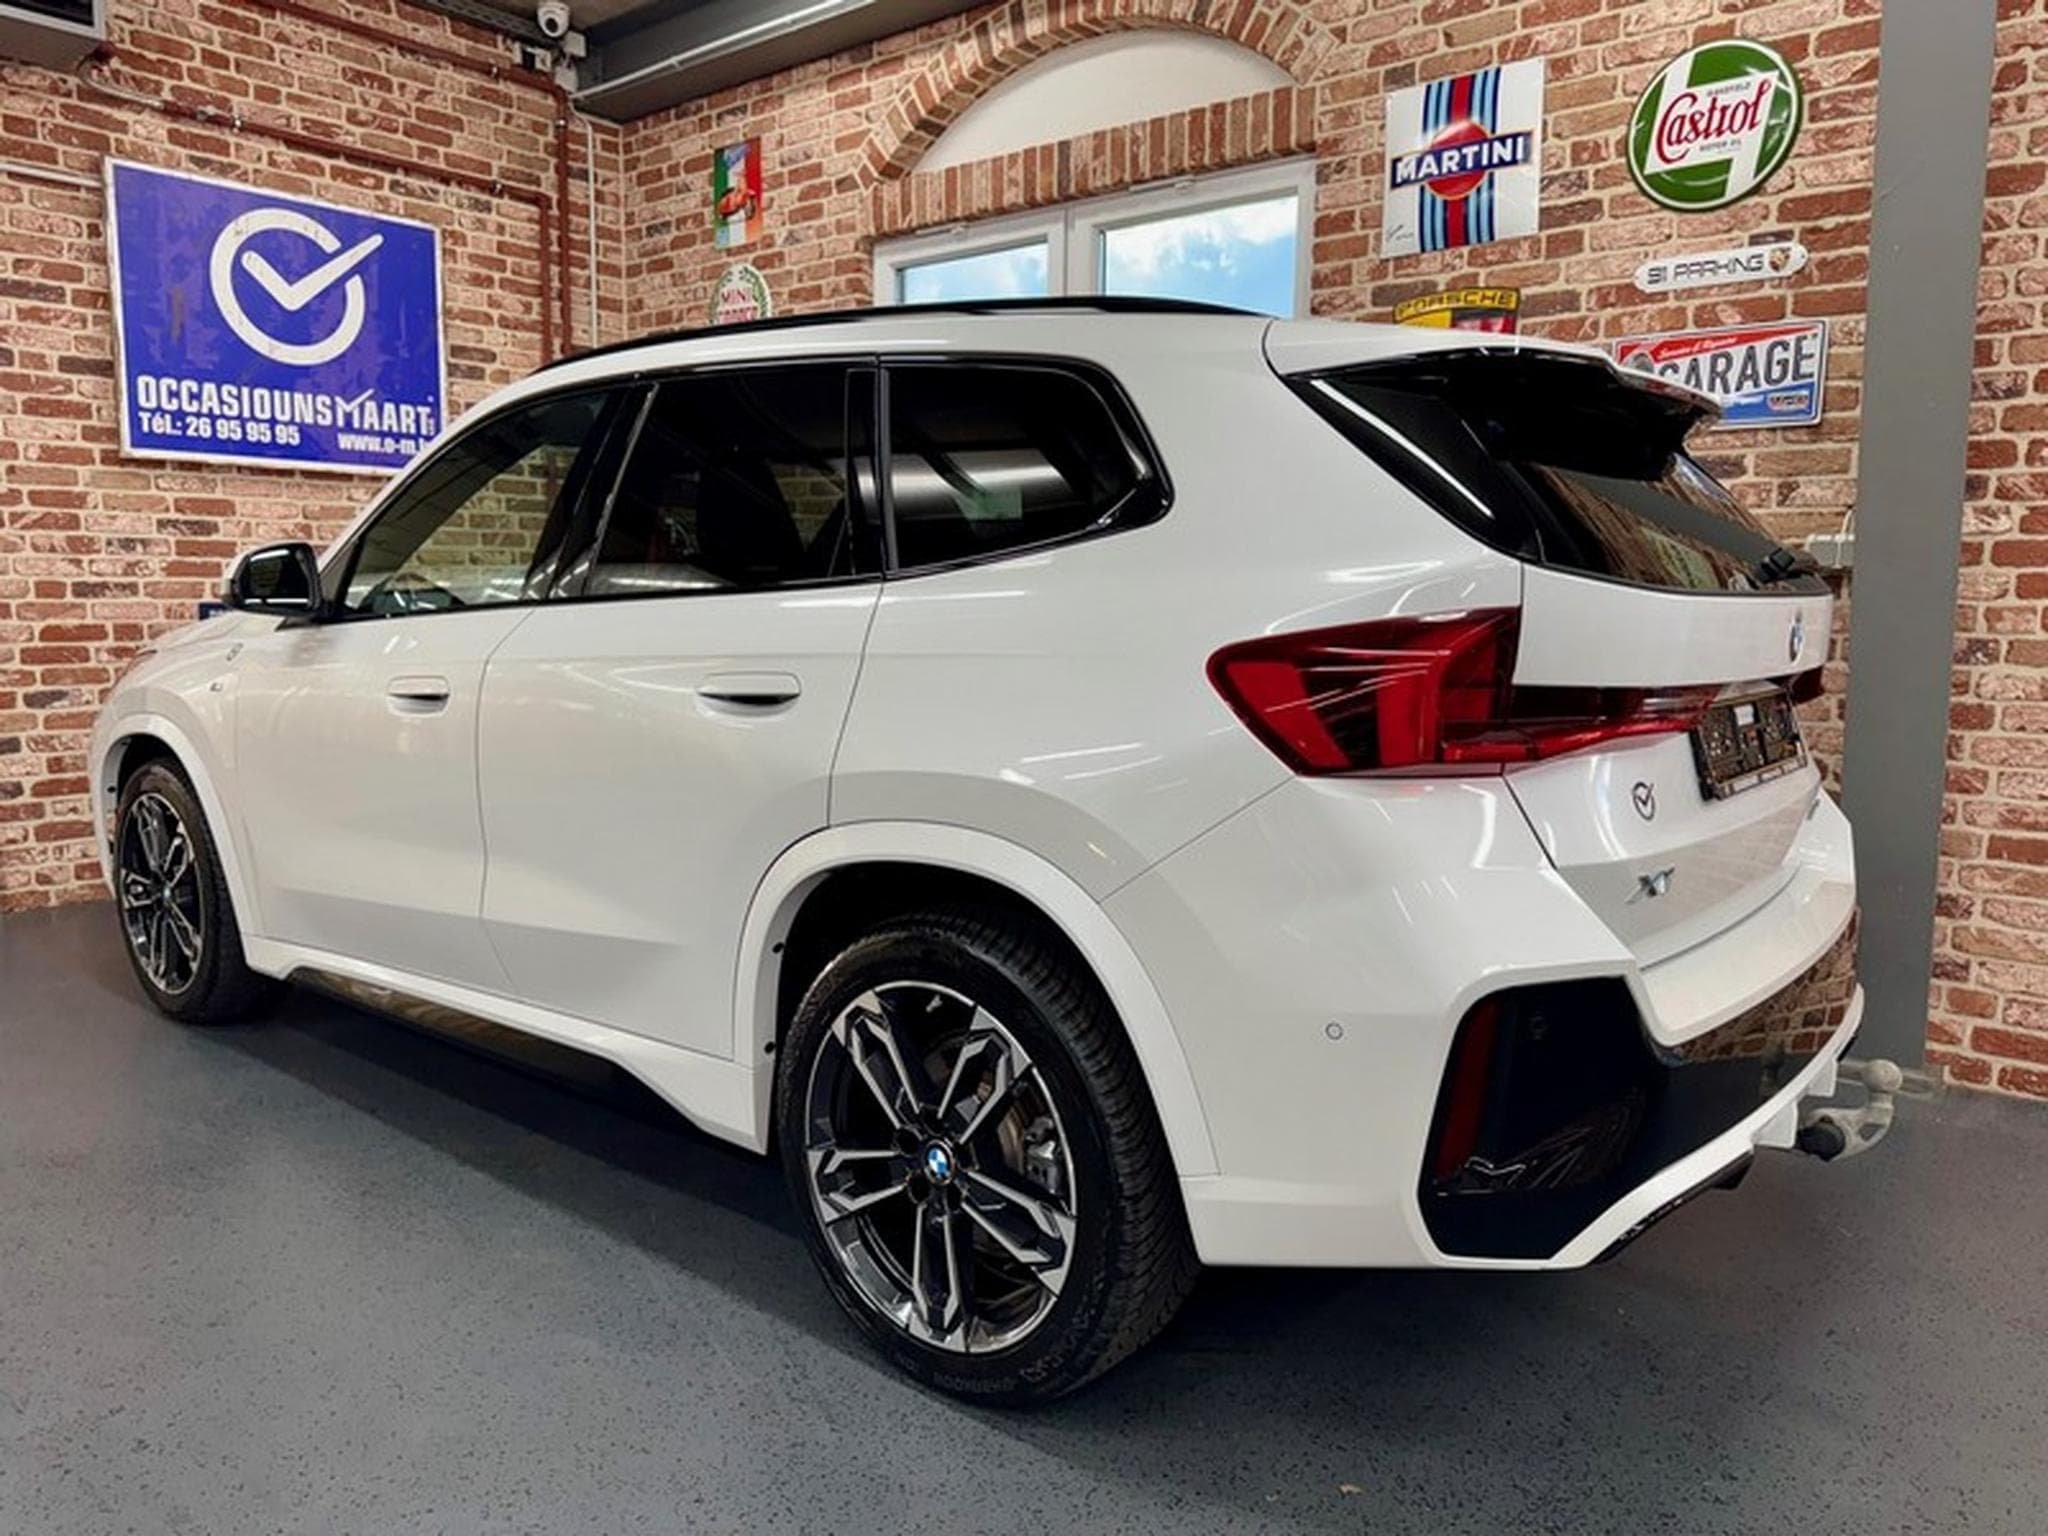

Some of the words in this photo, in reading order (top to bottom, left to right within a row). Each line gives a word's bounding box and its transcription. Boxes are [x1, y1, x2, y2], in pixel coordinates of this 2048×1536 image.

[1656, 78, 1772, 165] Castrol
[1395, 136, 1524, 184] MARTINI
[1674, 253, 1764, 281] PARKING
[186, 415, 212, 438] 26
[216, 418, 242, 441] 95
[246, 421, 272, 443] 95
[275, 424, 301, 446] 95
